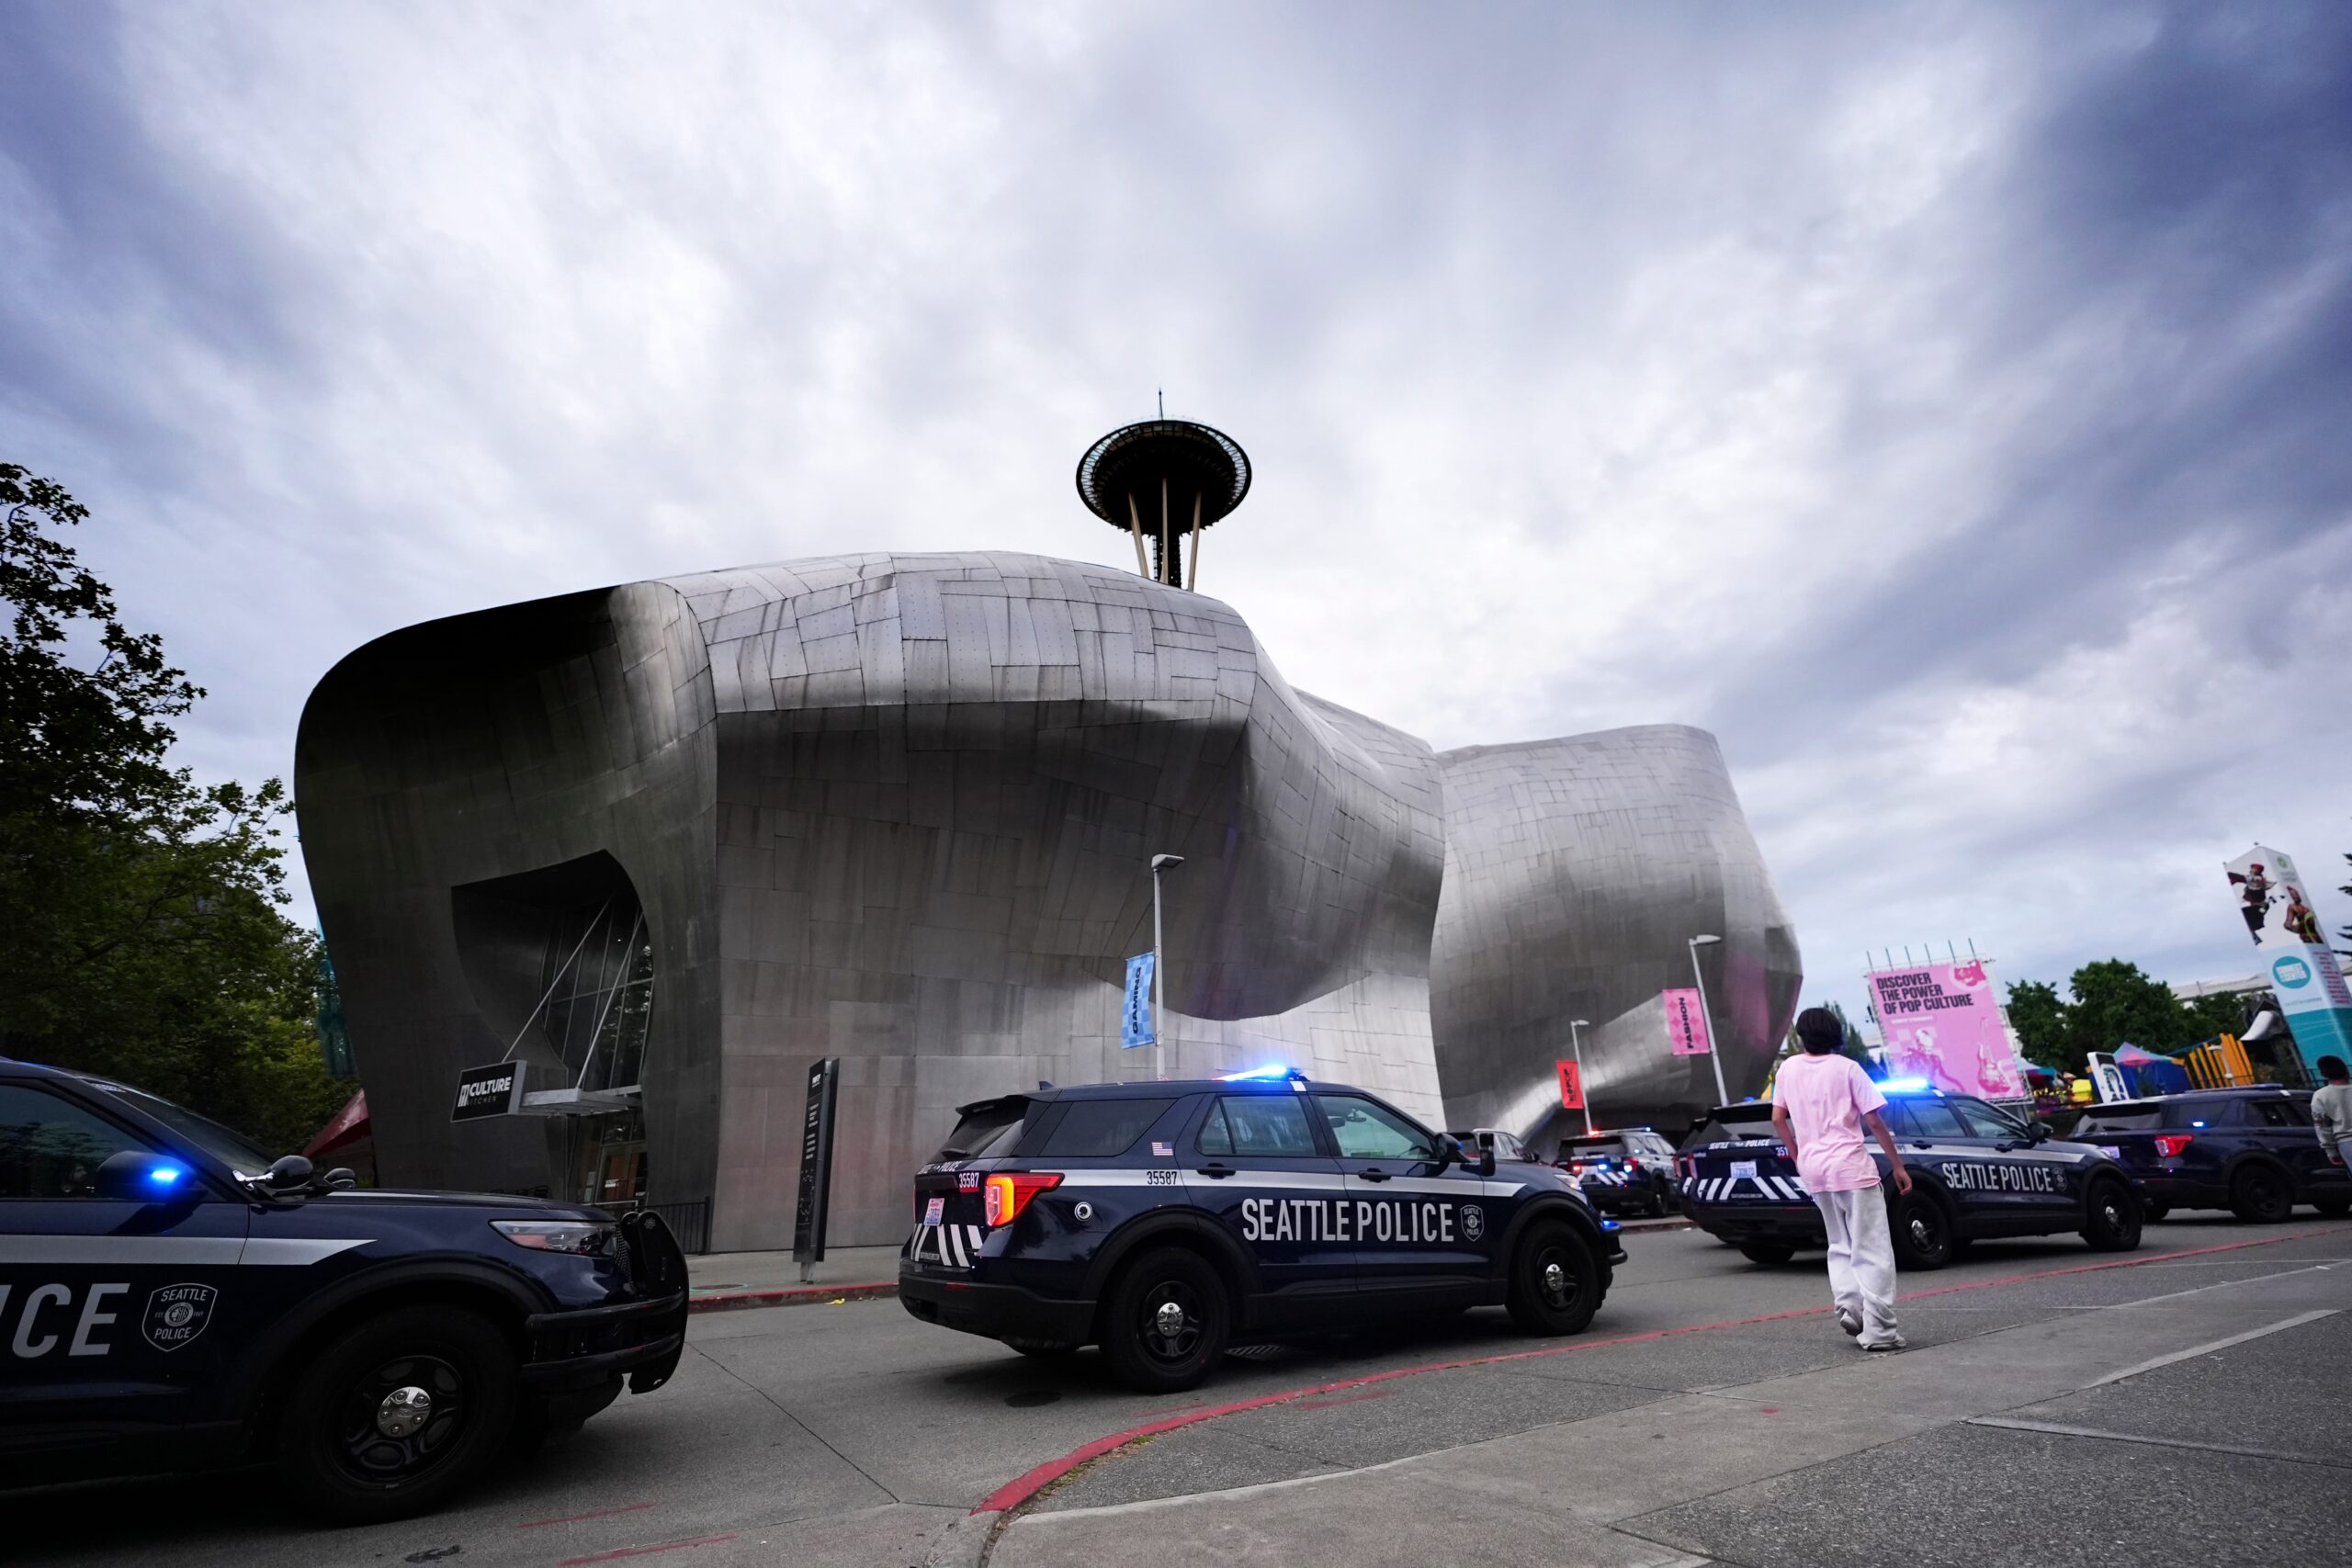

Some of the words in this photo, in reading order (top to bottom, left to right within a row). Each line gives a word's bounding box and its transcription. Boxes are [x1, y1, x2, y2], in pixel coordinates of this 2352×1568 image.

[1876, 972, 1932, 989] DISCOVER
[1132, 967, 1141, 1034] GAMING
[1880, 988, 1901, 1002] THE
[1903, 984, 1943, 999] POWER
[1883, 1002, 1897, 1015] OF
[1898, 999, 1922, 1014] POP
[1923, 994, 1974, 1010] CULTURE
[1679, 997, 1693, 1048] FASHION
[469, 1077, 512, 1097] CULTURE
[1746, 1139, 1770, 1147] POLICE
[959, 1172, 979, 1188] 35587
[1147, 1171, 1177, 1185] 35587
[1941, 1163, 1999, 1190] SEATTLE
[1999, 1166, 2053, 1191] POLICE
[1242, 1198, 1350, 1241] SEATTLE
[1357, 1201, 1454, 1242] POLICE
[161, 1289, 208, 1303] SEATTLE
[154, 1327, 192, 1339] POLICE
